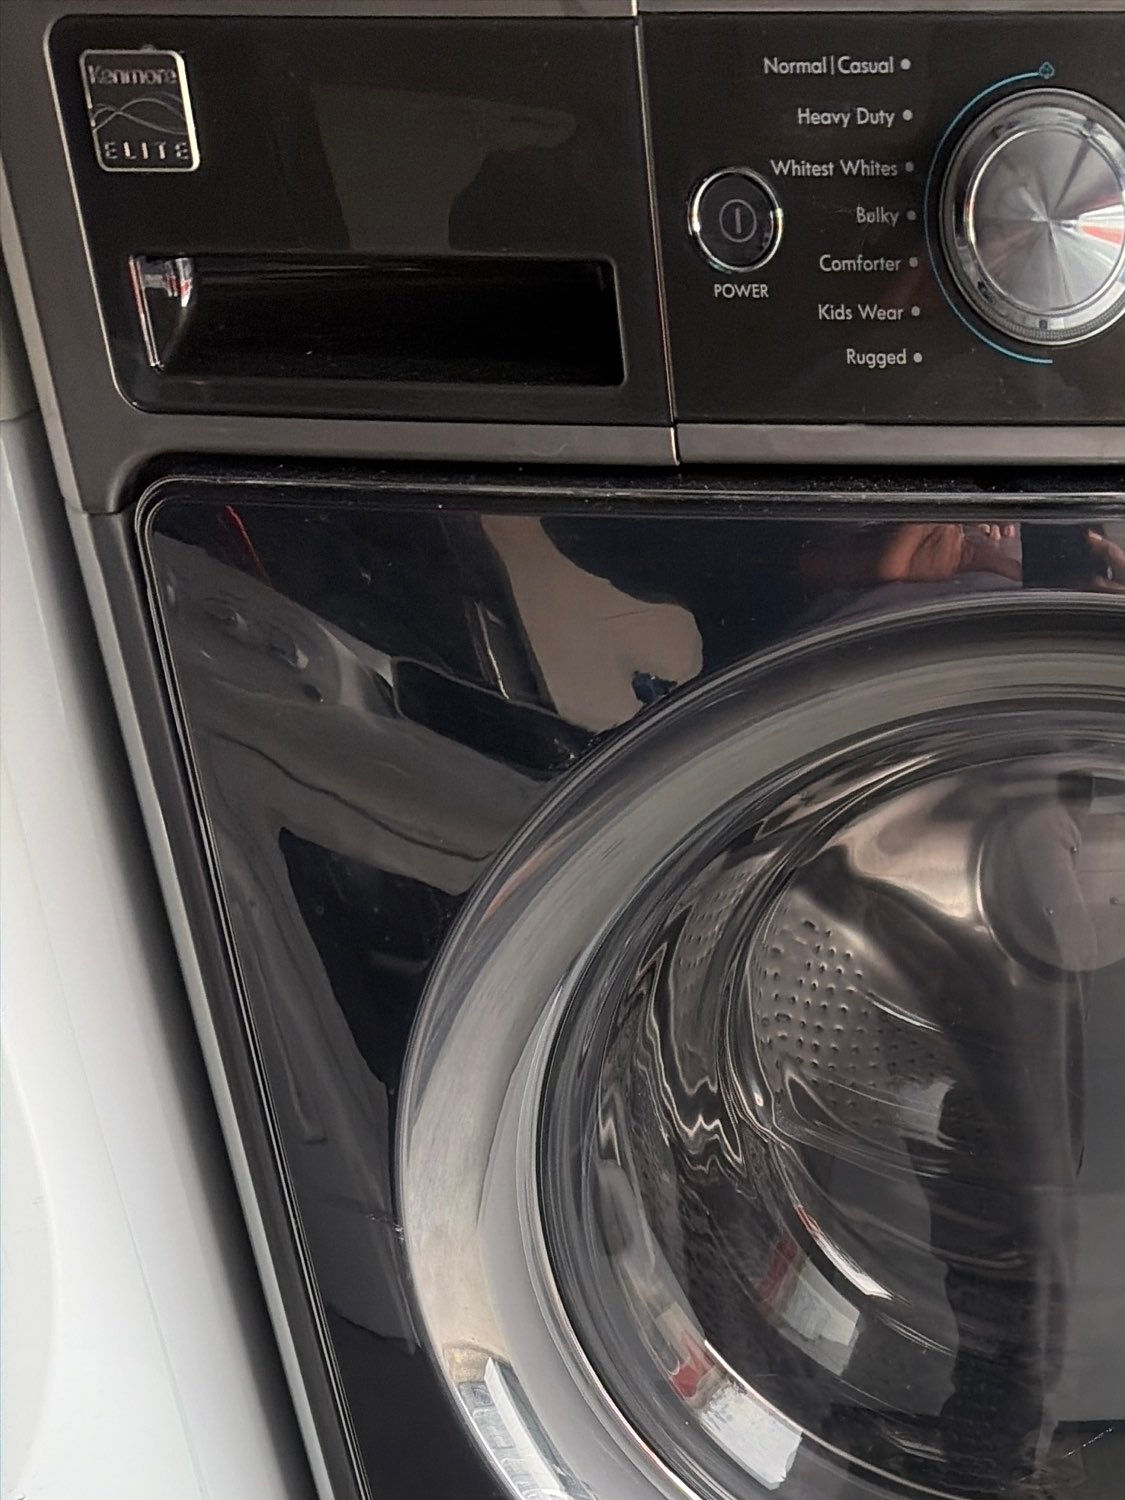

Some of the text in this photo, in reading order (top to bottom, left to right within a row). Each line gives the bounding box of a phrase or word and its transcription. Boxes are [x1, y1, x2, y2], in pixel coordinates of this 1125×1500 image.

[88, 65, 177, 85] Kenmore
[797, 107, 895, 128] Heavy Duty
[103, 141, 189, 160] ELITE
[770, 159, 898, 177] Whitest Whites
[856, 207, 899, 227] Bulky
[819, 254, 901, 272] Comforter
[714, 283, 769, 299] POWER
[818, 304, 904, 321] Kids Wear
[846, 348, 907, 369] Rugged
